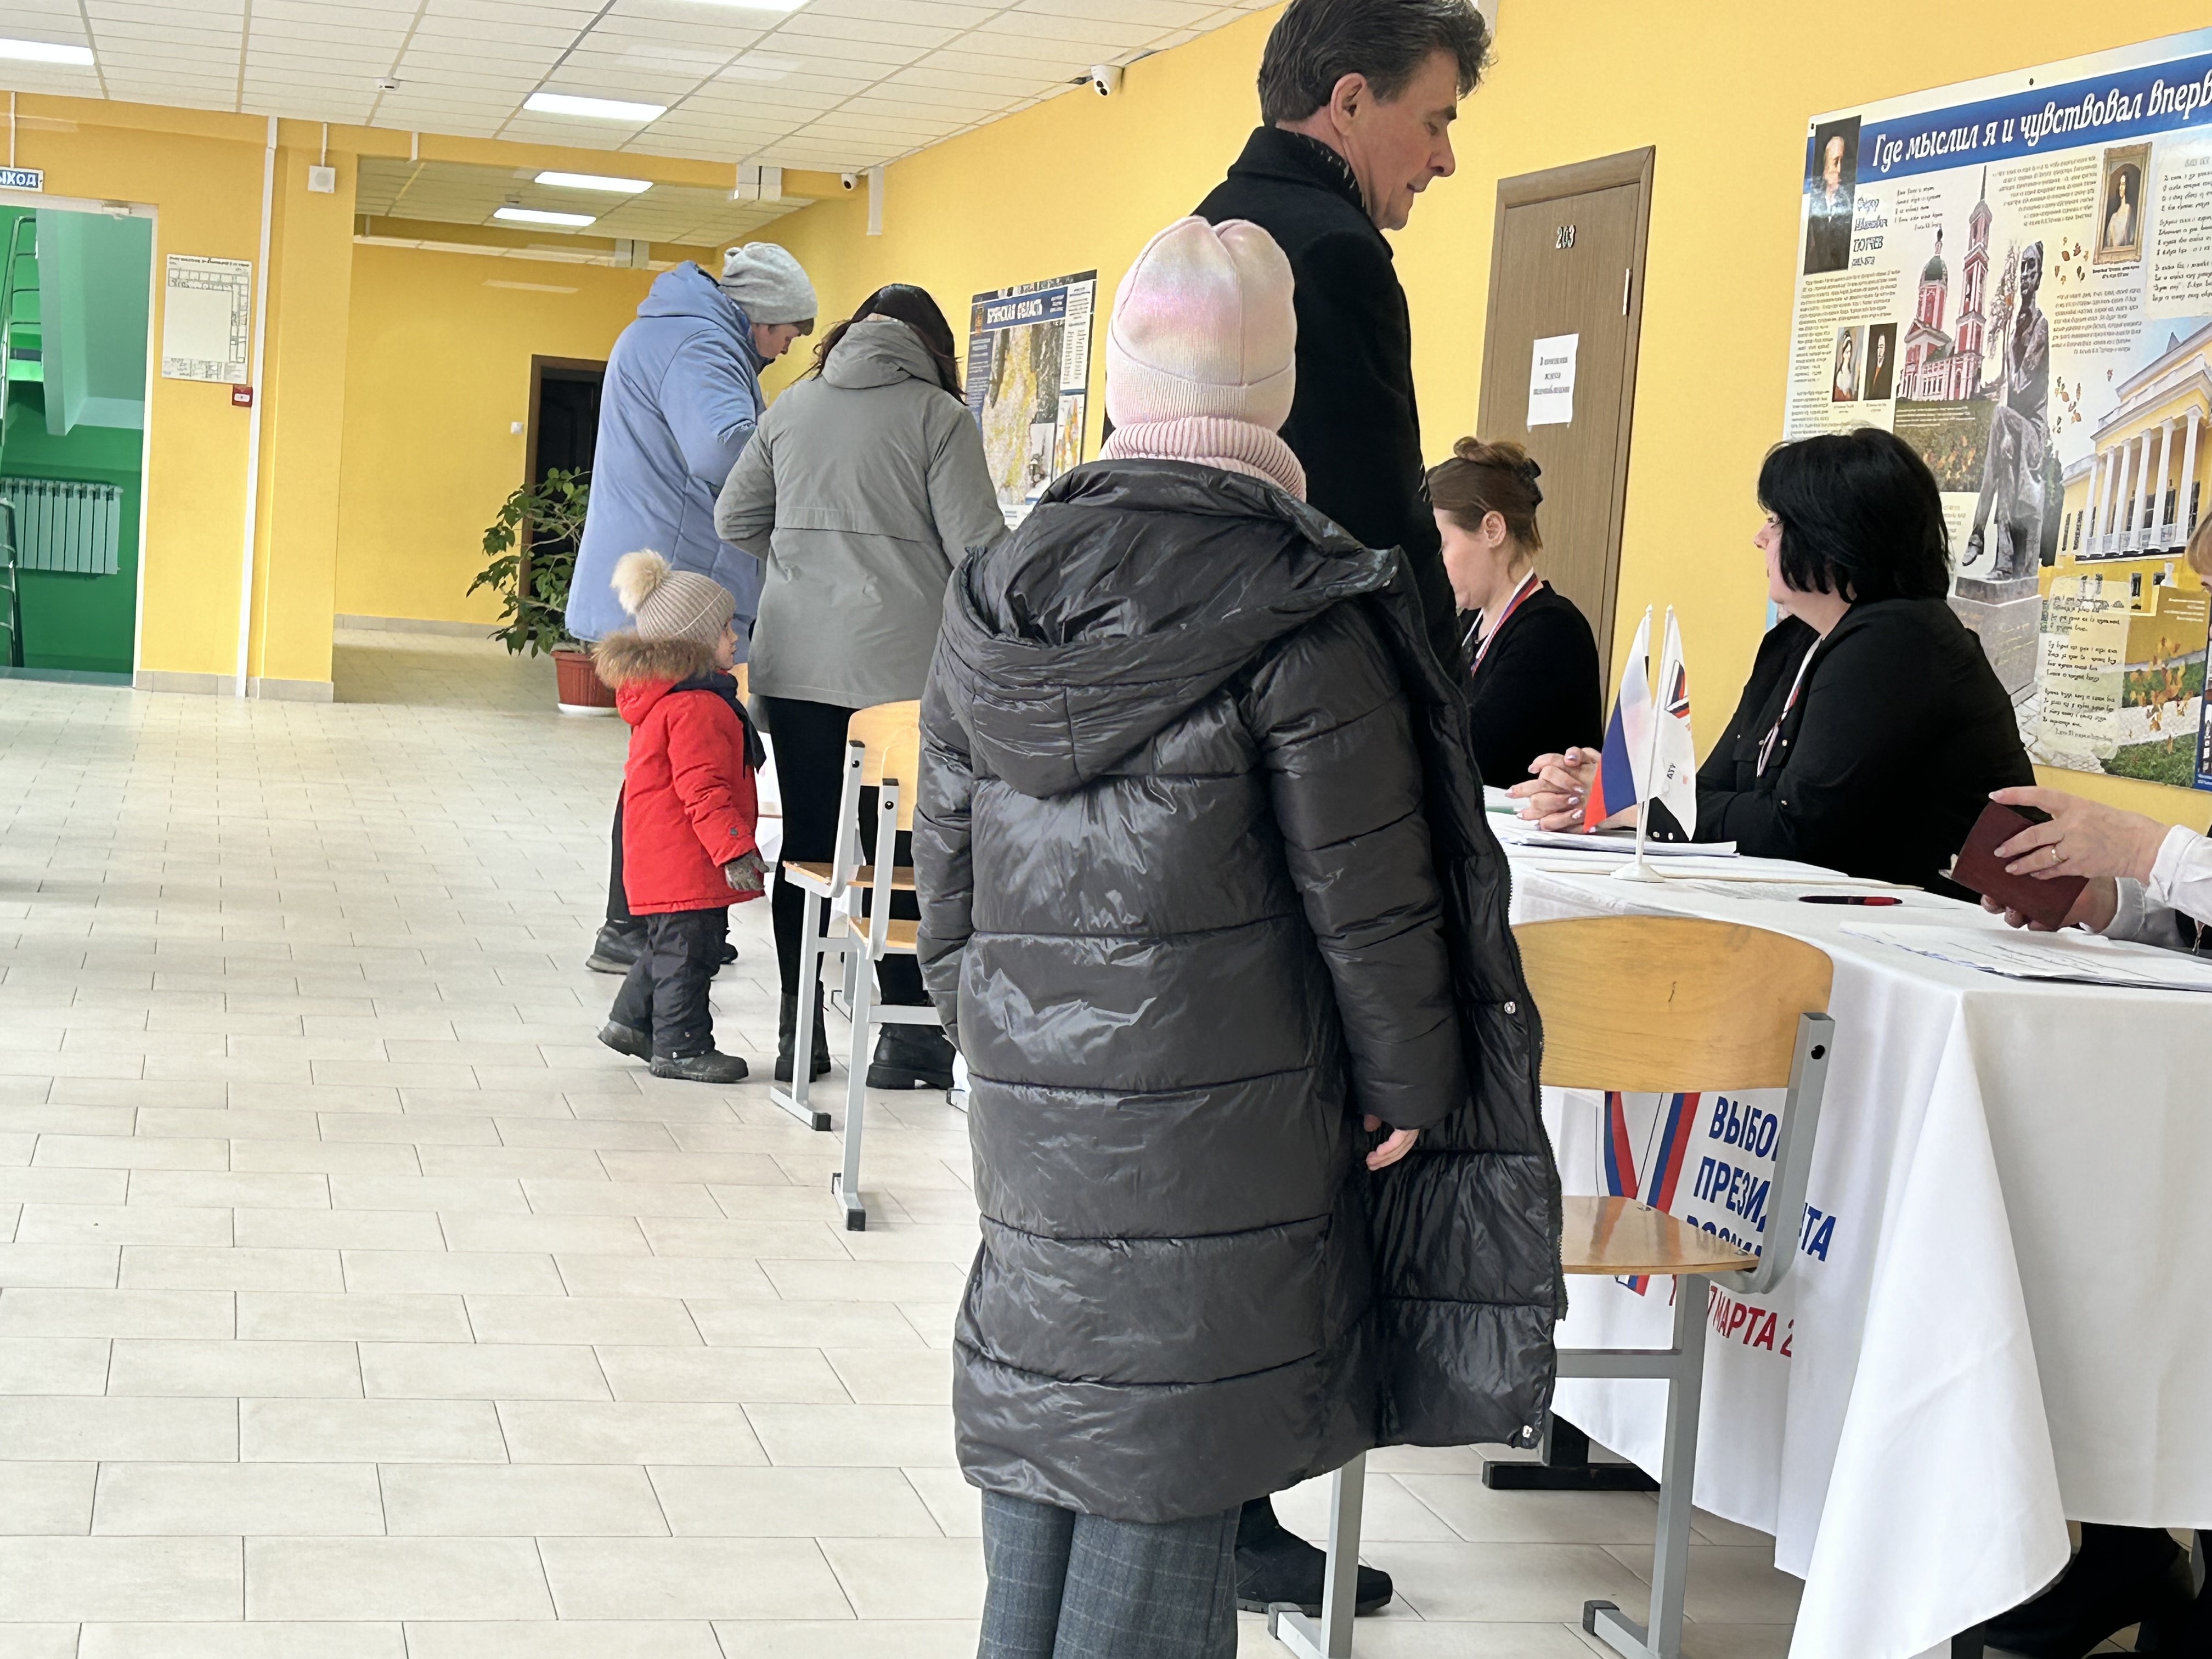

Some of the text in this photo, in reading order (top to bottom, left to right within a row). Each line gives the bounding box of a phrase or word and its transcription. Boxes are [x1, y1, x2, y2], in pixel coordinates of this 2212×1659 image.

[1872, 133, 1903, 173] Где
[1905, 125, 1979, 161] мыслил
[1982, 121, 1998, 147] я
[2002, 118, 2015, 144] и
[2021, 88, 2143, 147] чувствовал
[1555, 224, 1576, 249] 203
